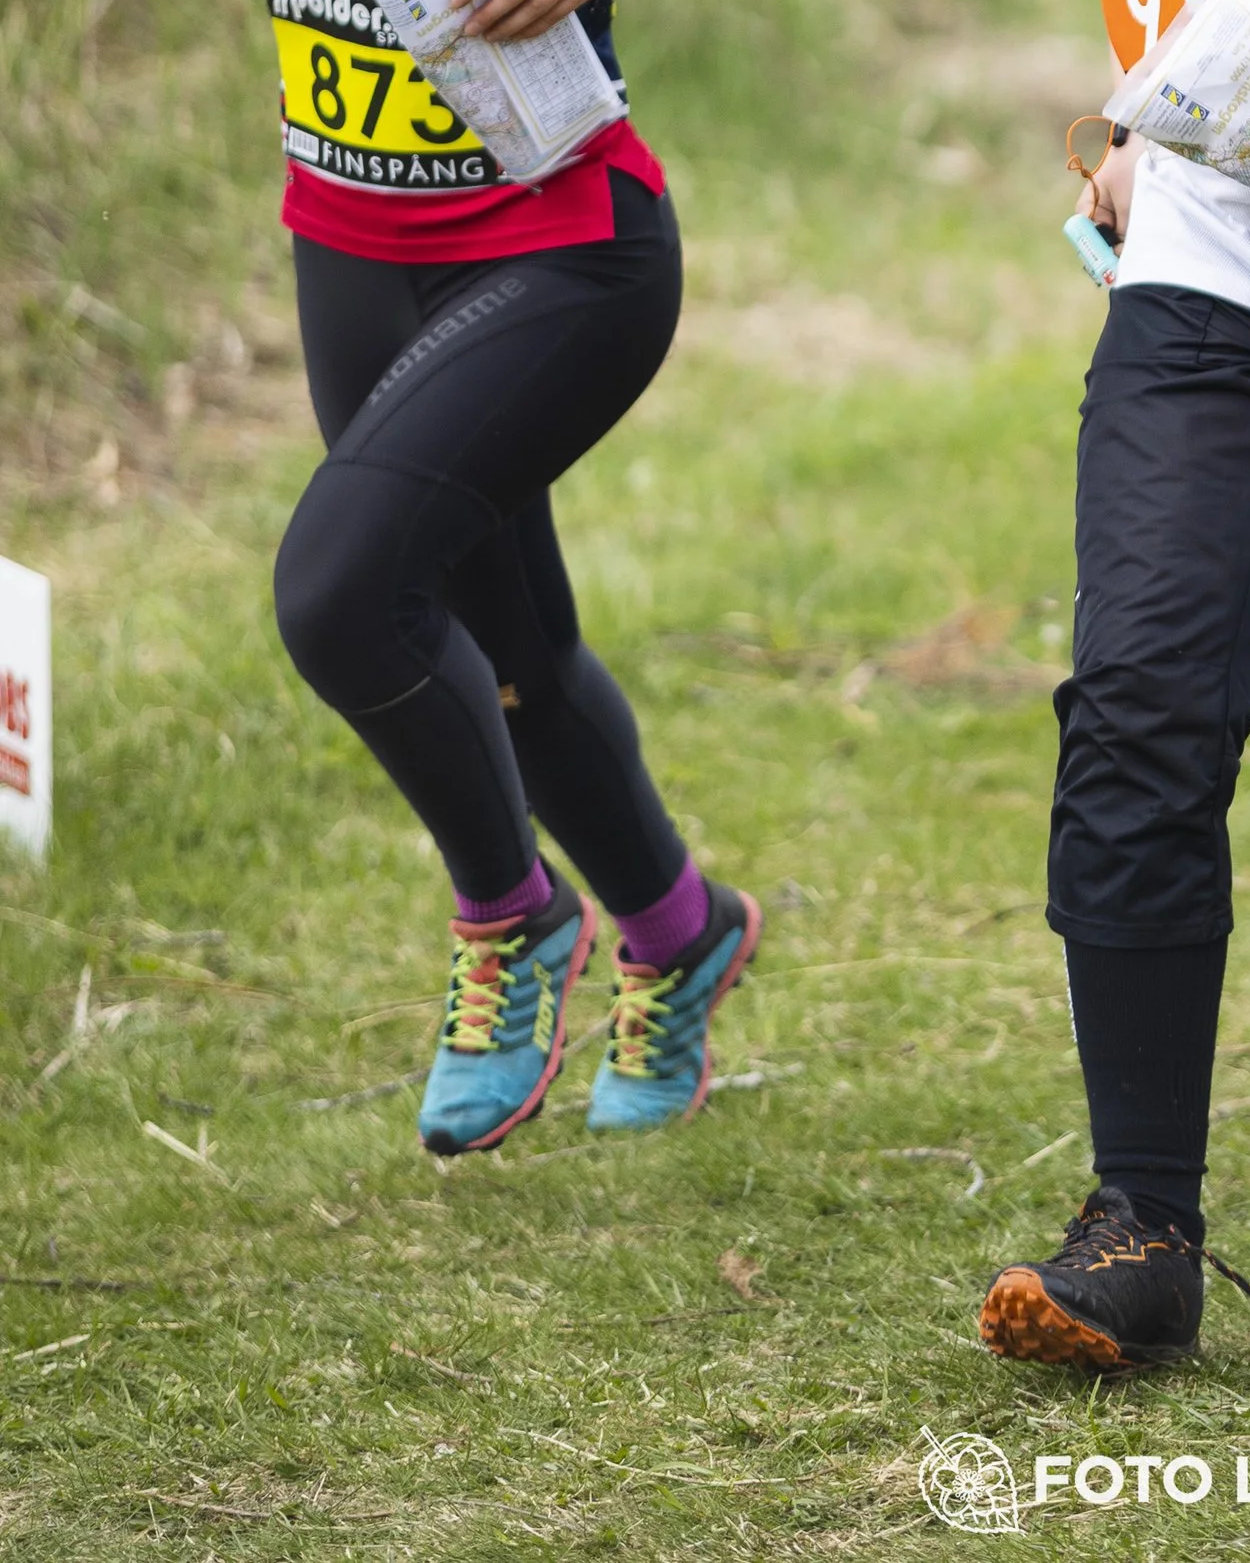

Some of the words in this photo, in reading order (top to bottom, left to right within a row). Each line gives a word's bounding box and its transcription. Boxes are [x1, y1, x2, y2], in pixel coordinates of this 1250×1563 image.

[311, 41, 468, 144] 873
[322, 141, 485, 185] FINSPÅNG
[368, 277, 527, 407] noname
